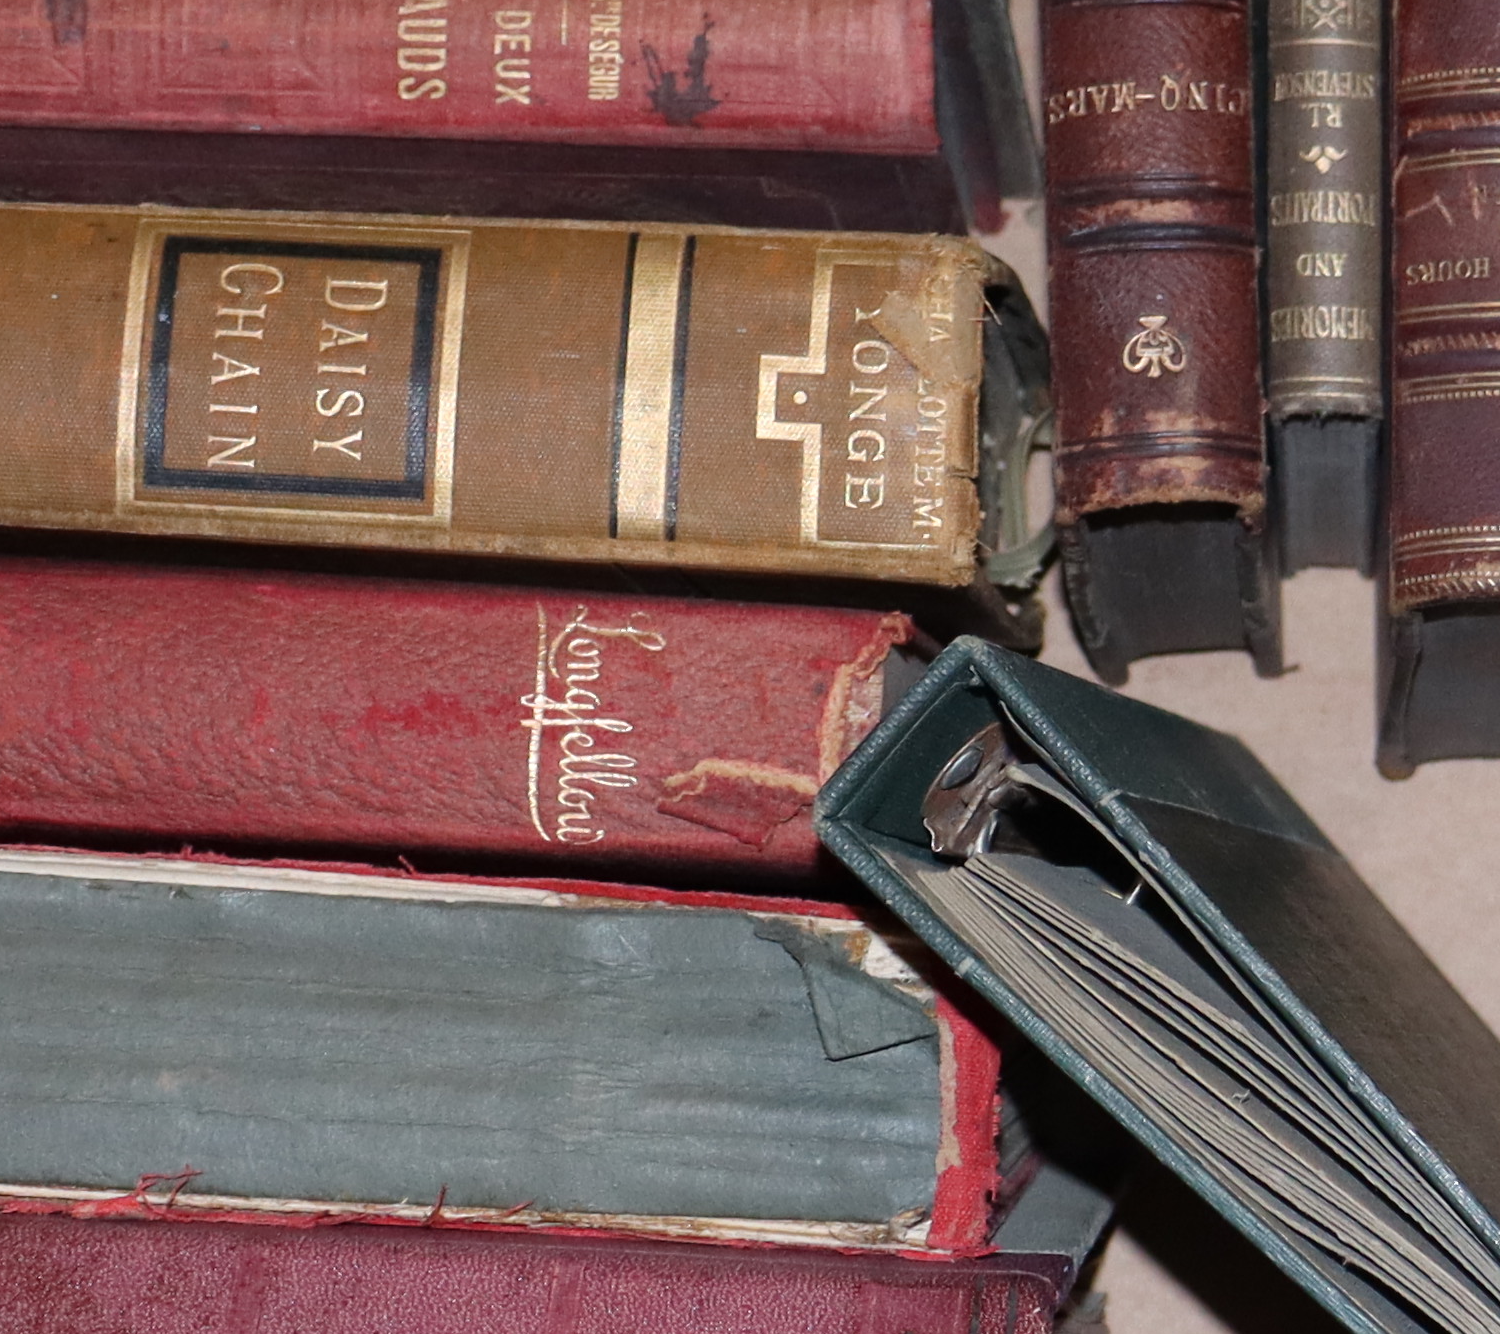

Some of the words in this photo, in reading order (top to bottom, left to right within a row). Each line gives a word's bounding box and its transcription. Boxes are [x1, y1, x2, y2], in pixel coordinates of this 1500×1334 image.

[493, 9, 533, 106] DEUX
[588, 39, 625, 101] SÉGUR
[1270, 190, 1377, 227] PORTRAITS
[1295, 251, 1349, 278] AND
[1405, 256, 1491, 286] HOURS
[1270, 304, 1376, 343] MEMORIES
[206, 263, 286, 468] CHAIN
[312, 274, 390, 462] DAISY
[520, 603, 669, 845] Longfellow
